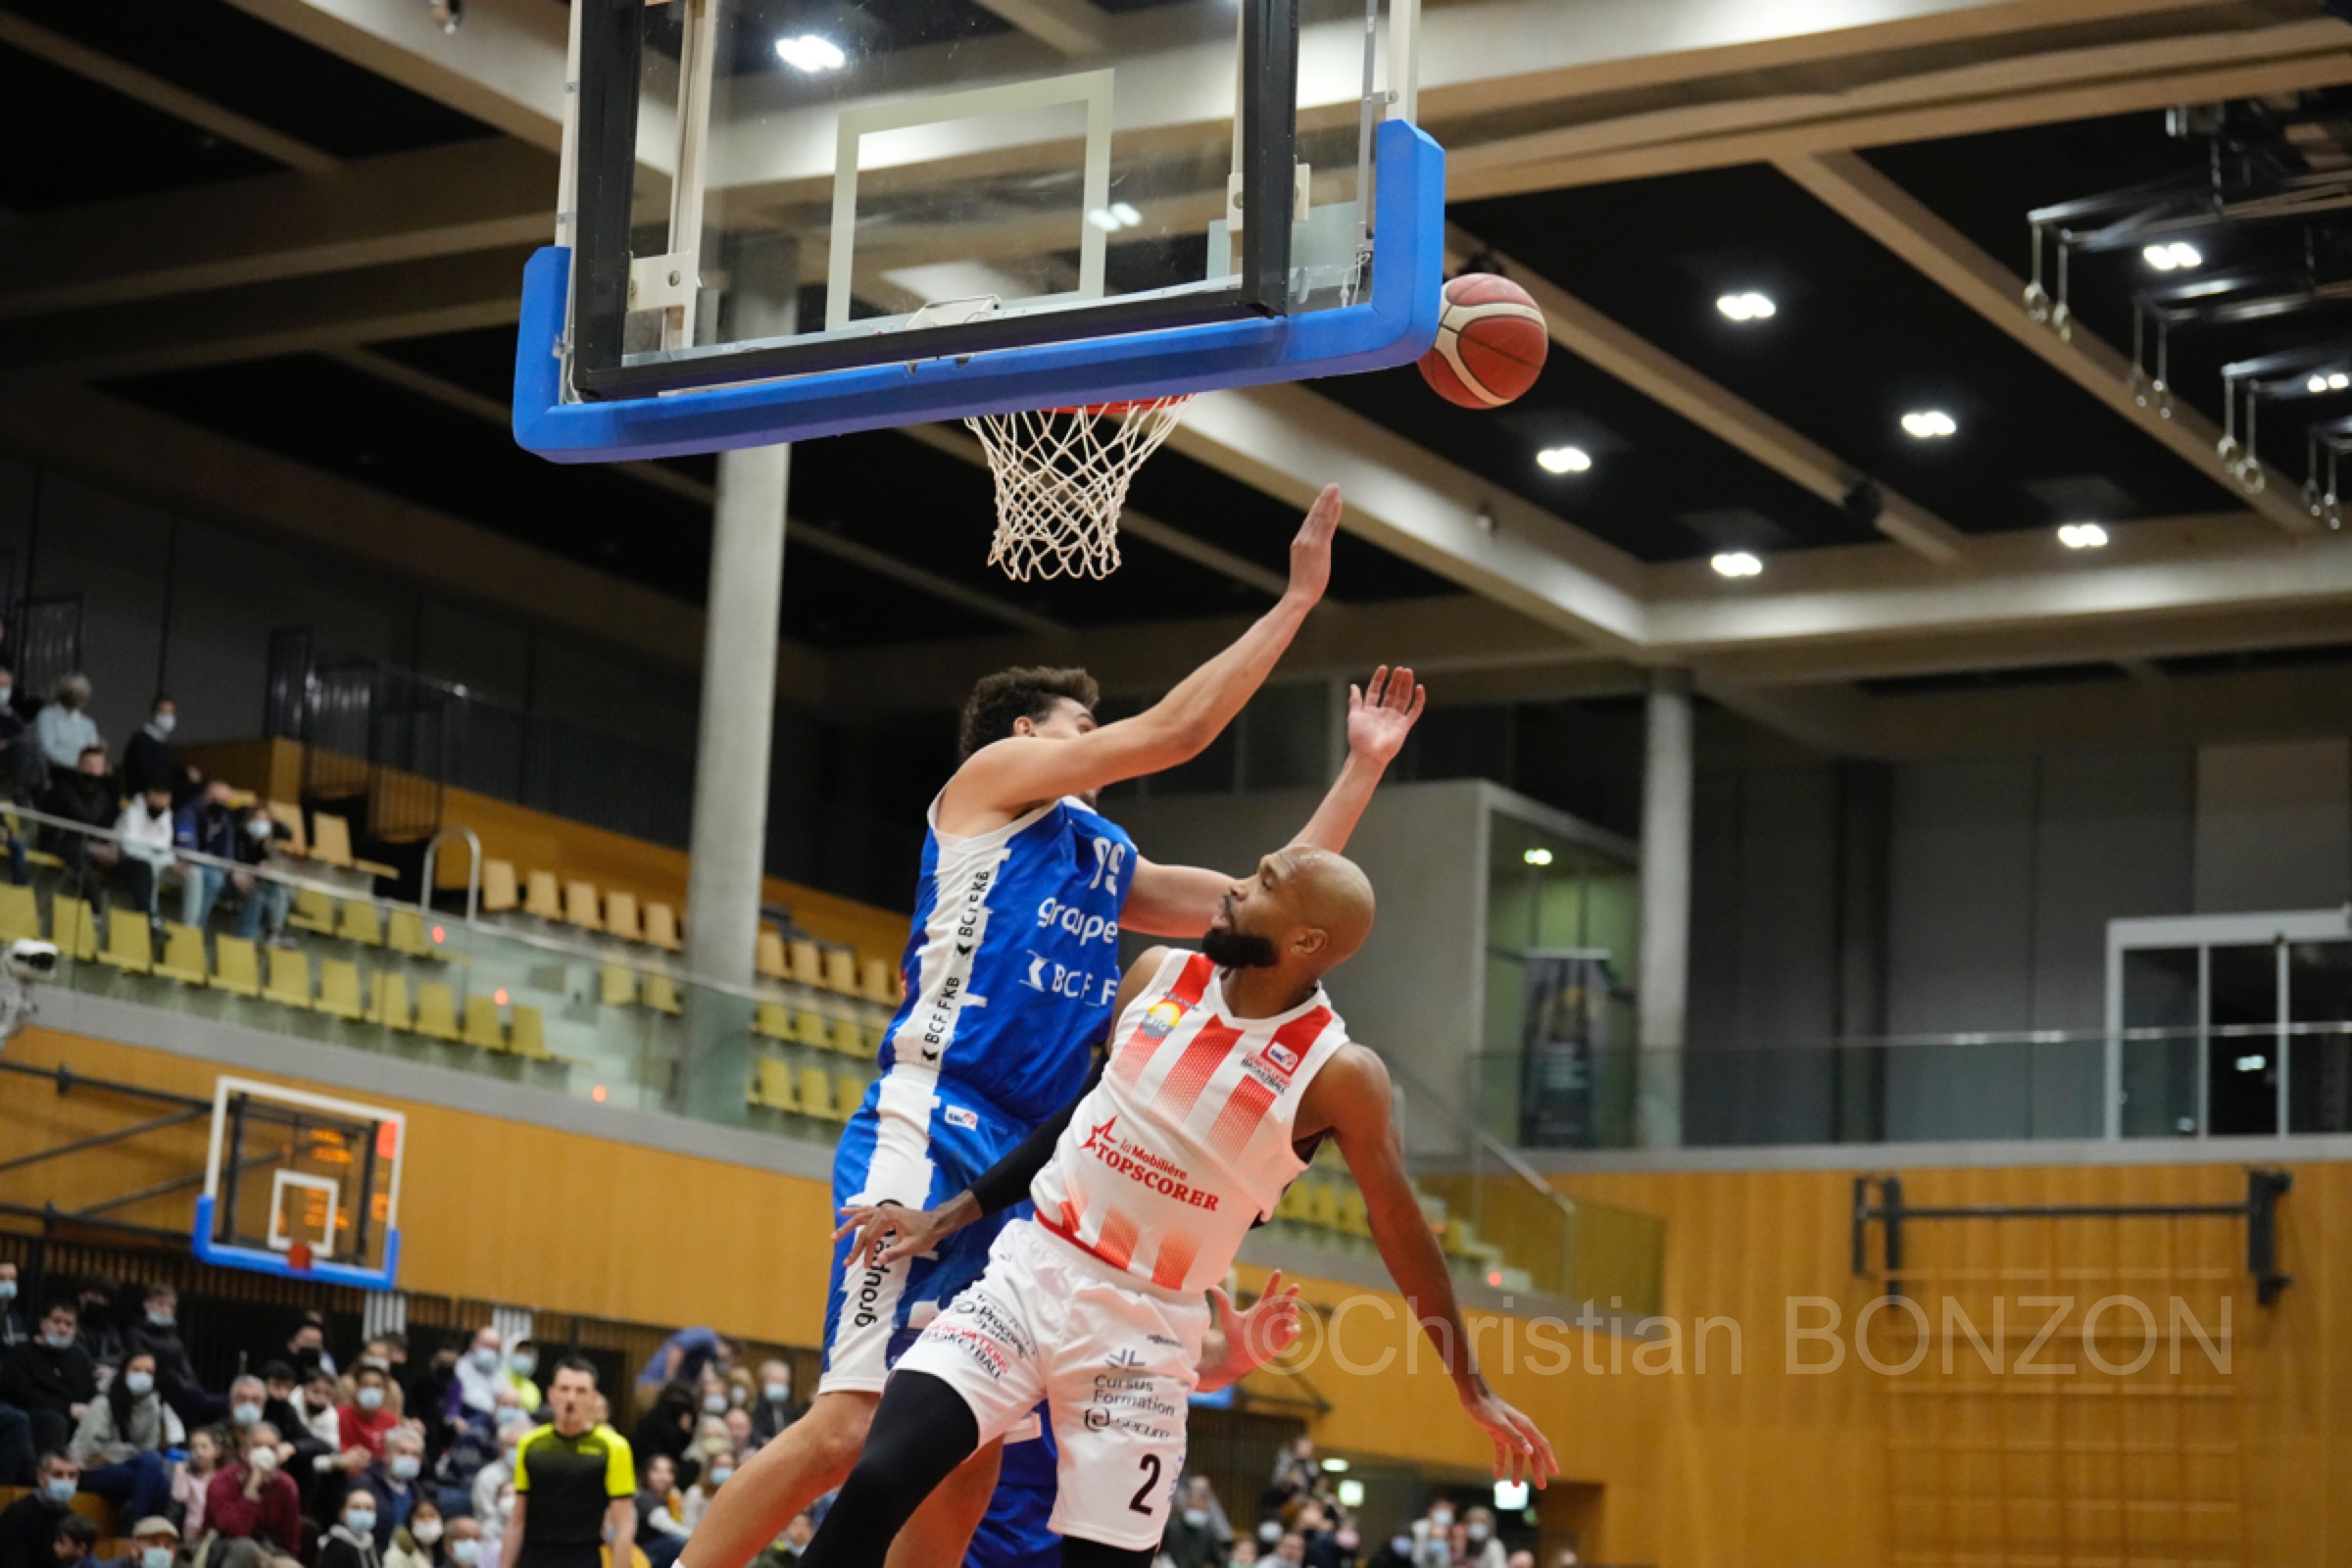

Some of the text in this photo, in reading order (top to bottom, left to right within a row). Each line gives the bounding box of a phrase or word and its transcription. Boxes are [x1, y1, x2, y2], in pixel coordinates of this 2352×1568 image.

[1096, 1143, 1220, 1212] TOPSCORER
[1093, 1373, 1154, 1393] Cursus
[1093, 1389, 1175, 1418] Formation
[1128, 1451, 1162, 1516] 2
